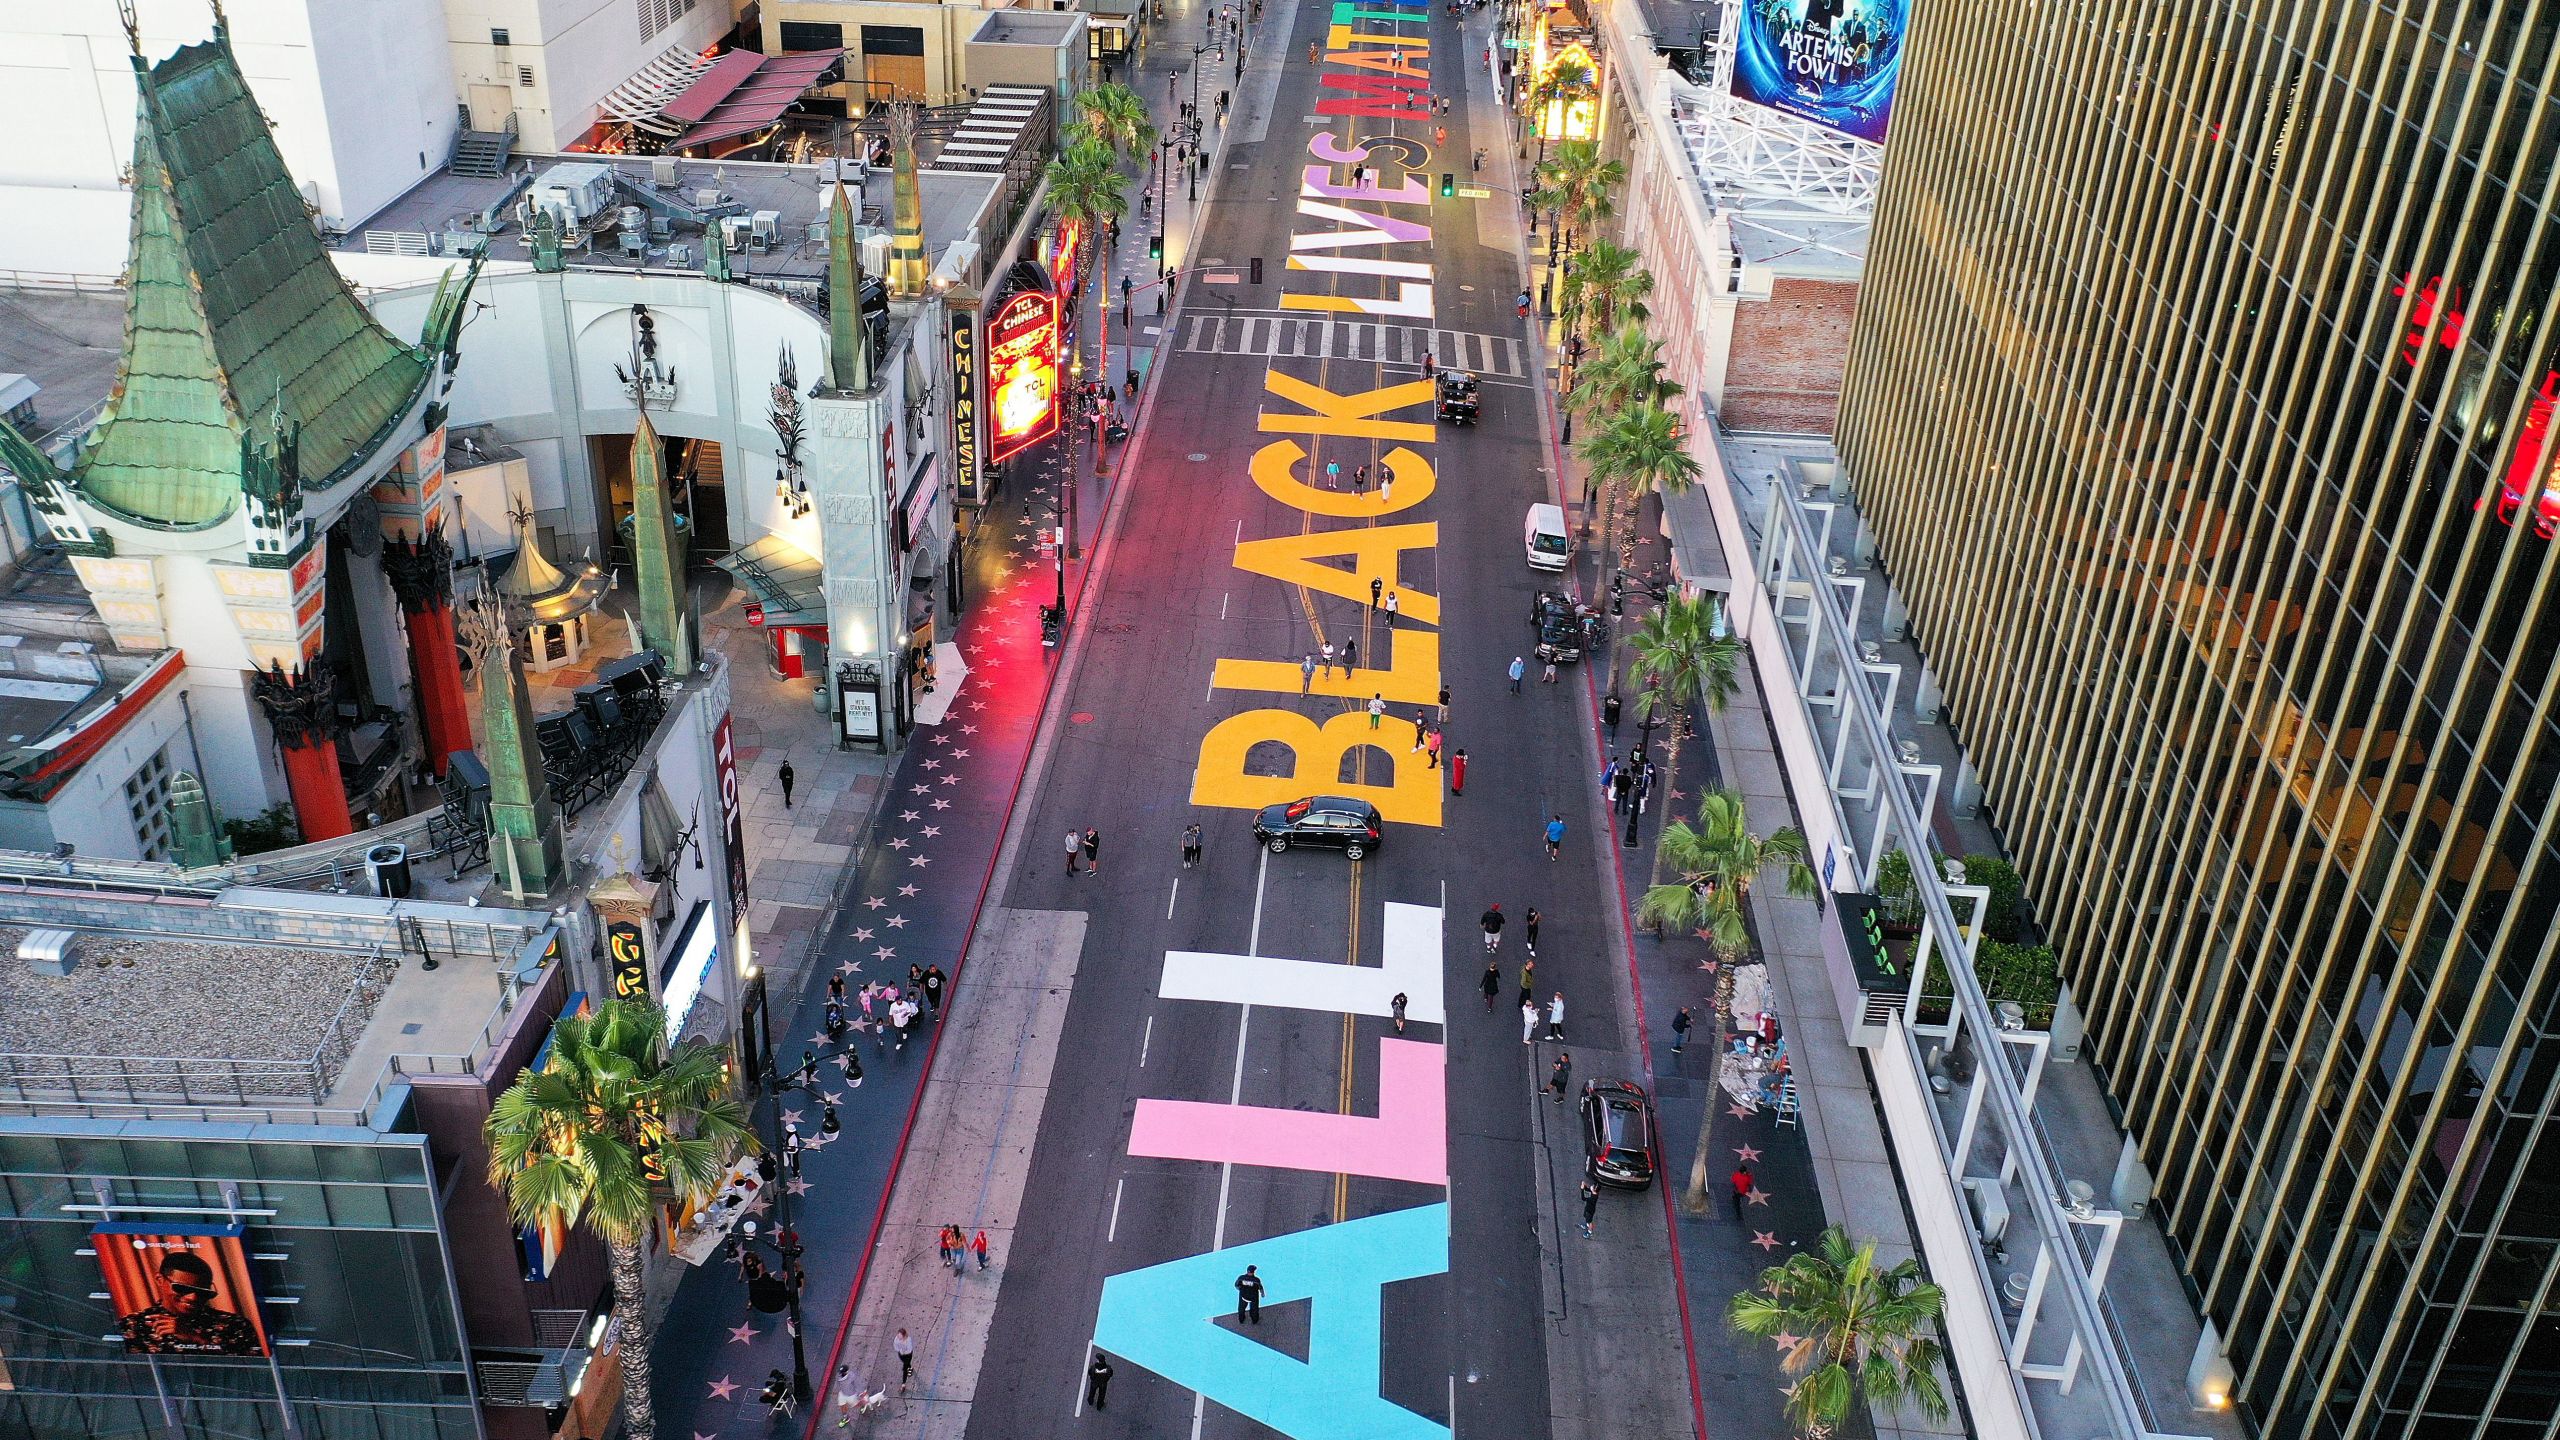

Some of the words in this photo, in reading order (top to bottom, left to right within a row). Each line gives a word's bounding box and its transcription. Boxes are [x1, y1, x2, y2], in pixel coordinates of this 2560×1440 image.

[1779, 30, 1855, 67] ARTEMIS
[1788, 51, 1837, 84] FOWL
[1279, 131, 1435, 319] LIVES
[1003, 304, 1044, 330] CHINESE
[1014, 298, 1033, 313] TCL
[955, 328, 974, 486] CHINESE
[1024, 380, 1046, 394] TCL
[886, 433, 898, 529] TCL
[1189, 368, 1443, 827] BLACK
[718, 725, 738, 847] TCL
[1092, 902, 1451, 1440] ALL
